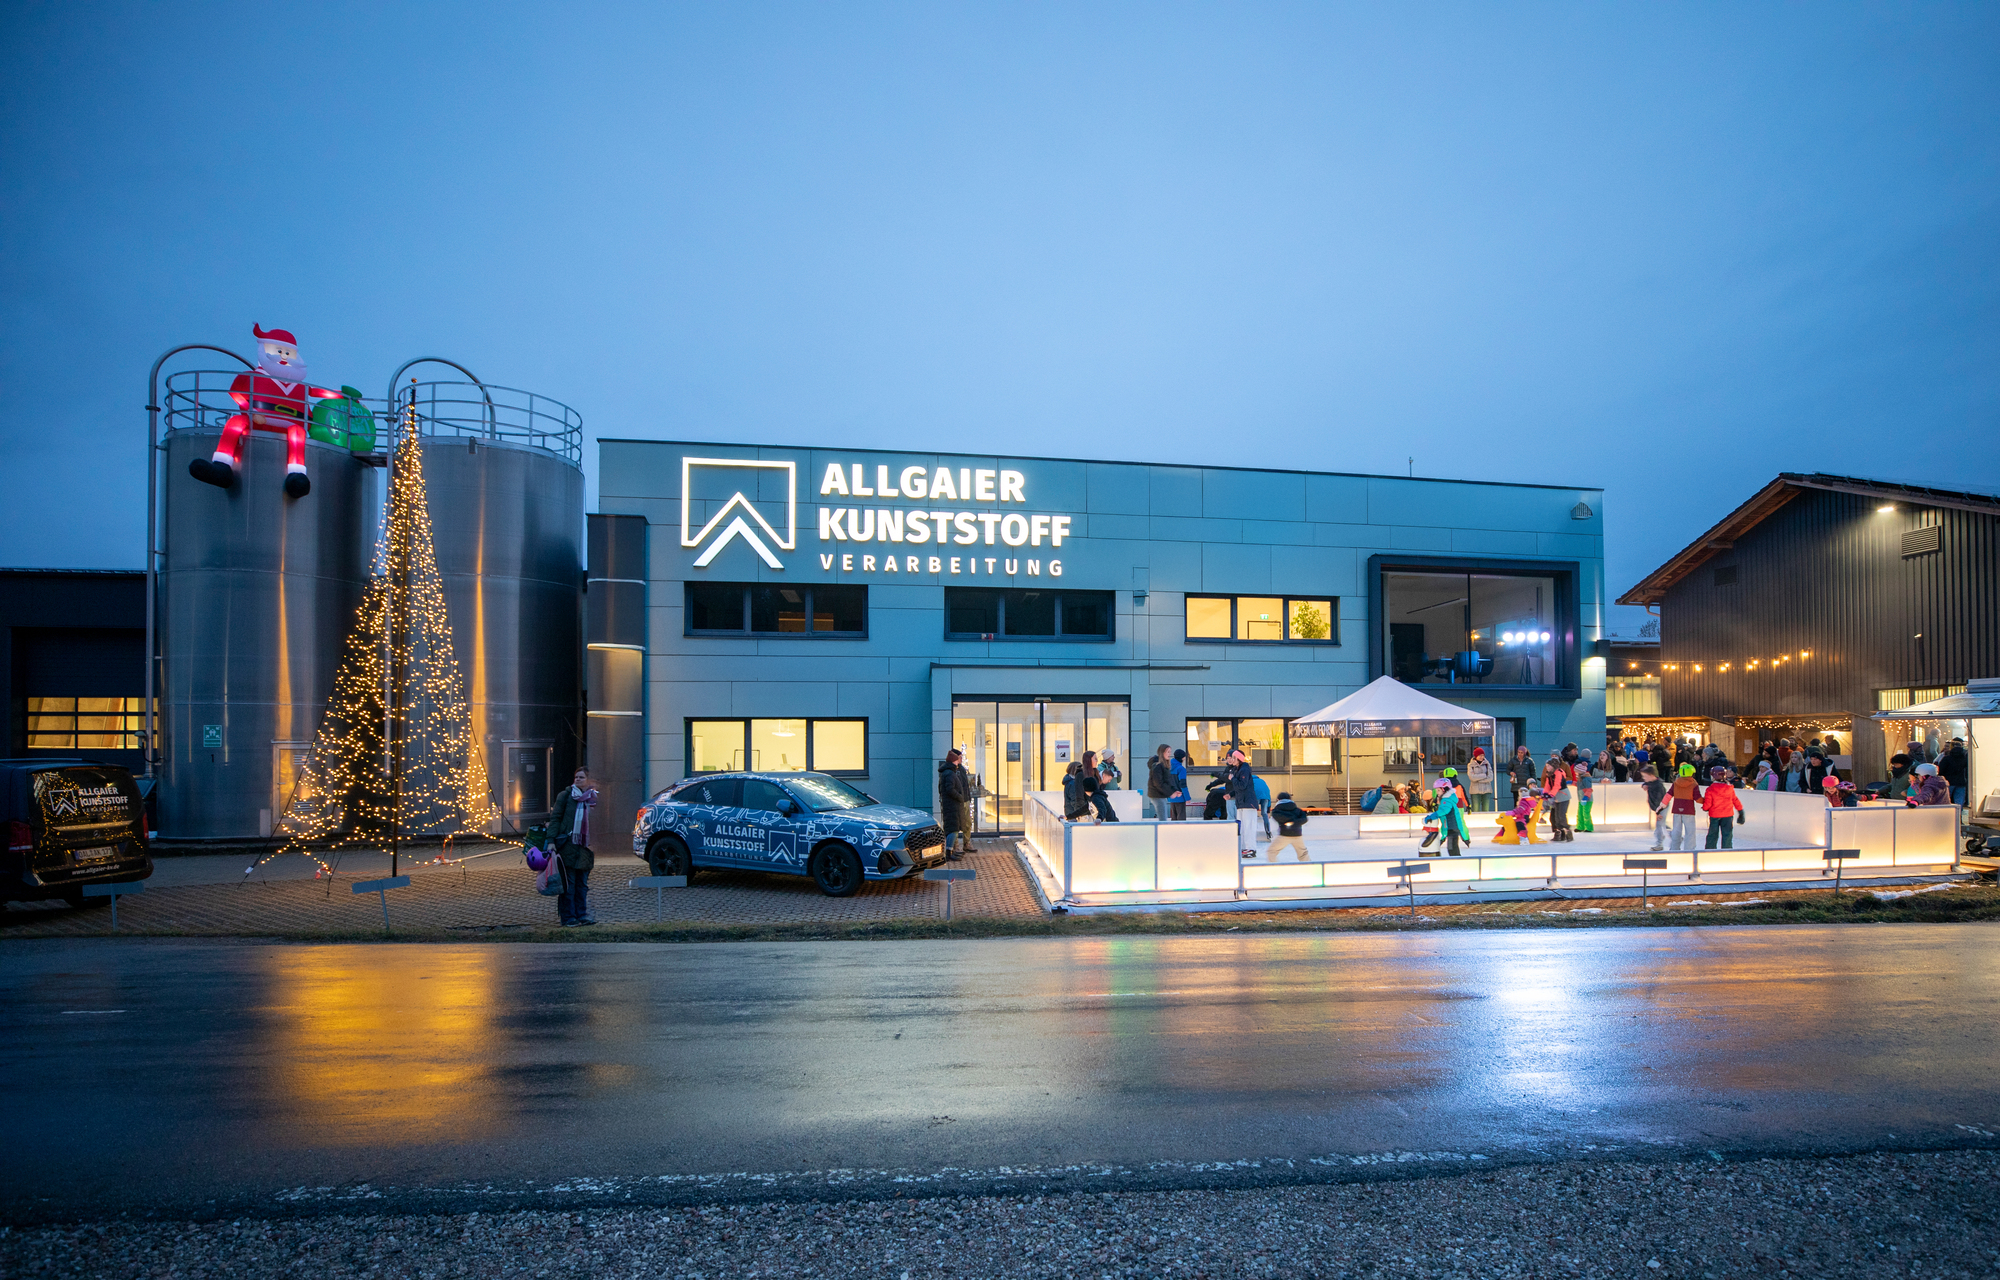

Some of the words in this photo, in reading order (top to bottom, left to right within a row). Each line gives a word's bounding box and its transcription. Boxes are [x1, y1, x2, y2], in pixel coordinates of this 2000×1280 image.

[820, 463, 1026, 502] ALLGAIER
[819, 507, 1072, 547] KUNSTSTOFF
[820, 553, 1063, 577] VERARBEITUNG
[211, 754, 214, 763] 1
[456, 761, 461, 769] 2
[78, 787, 119, 797] ALLGAIER
[80, 796, 129, 806] KUNSTSTOFF
[715, 824, 765, 839] ALLGAIER
[703, 836, 765, 852] KUNSTSTOFF
[704, 849, 764, 861] VERARBEITUNG
